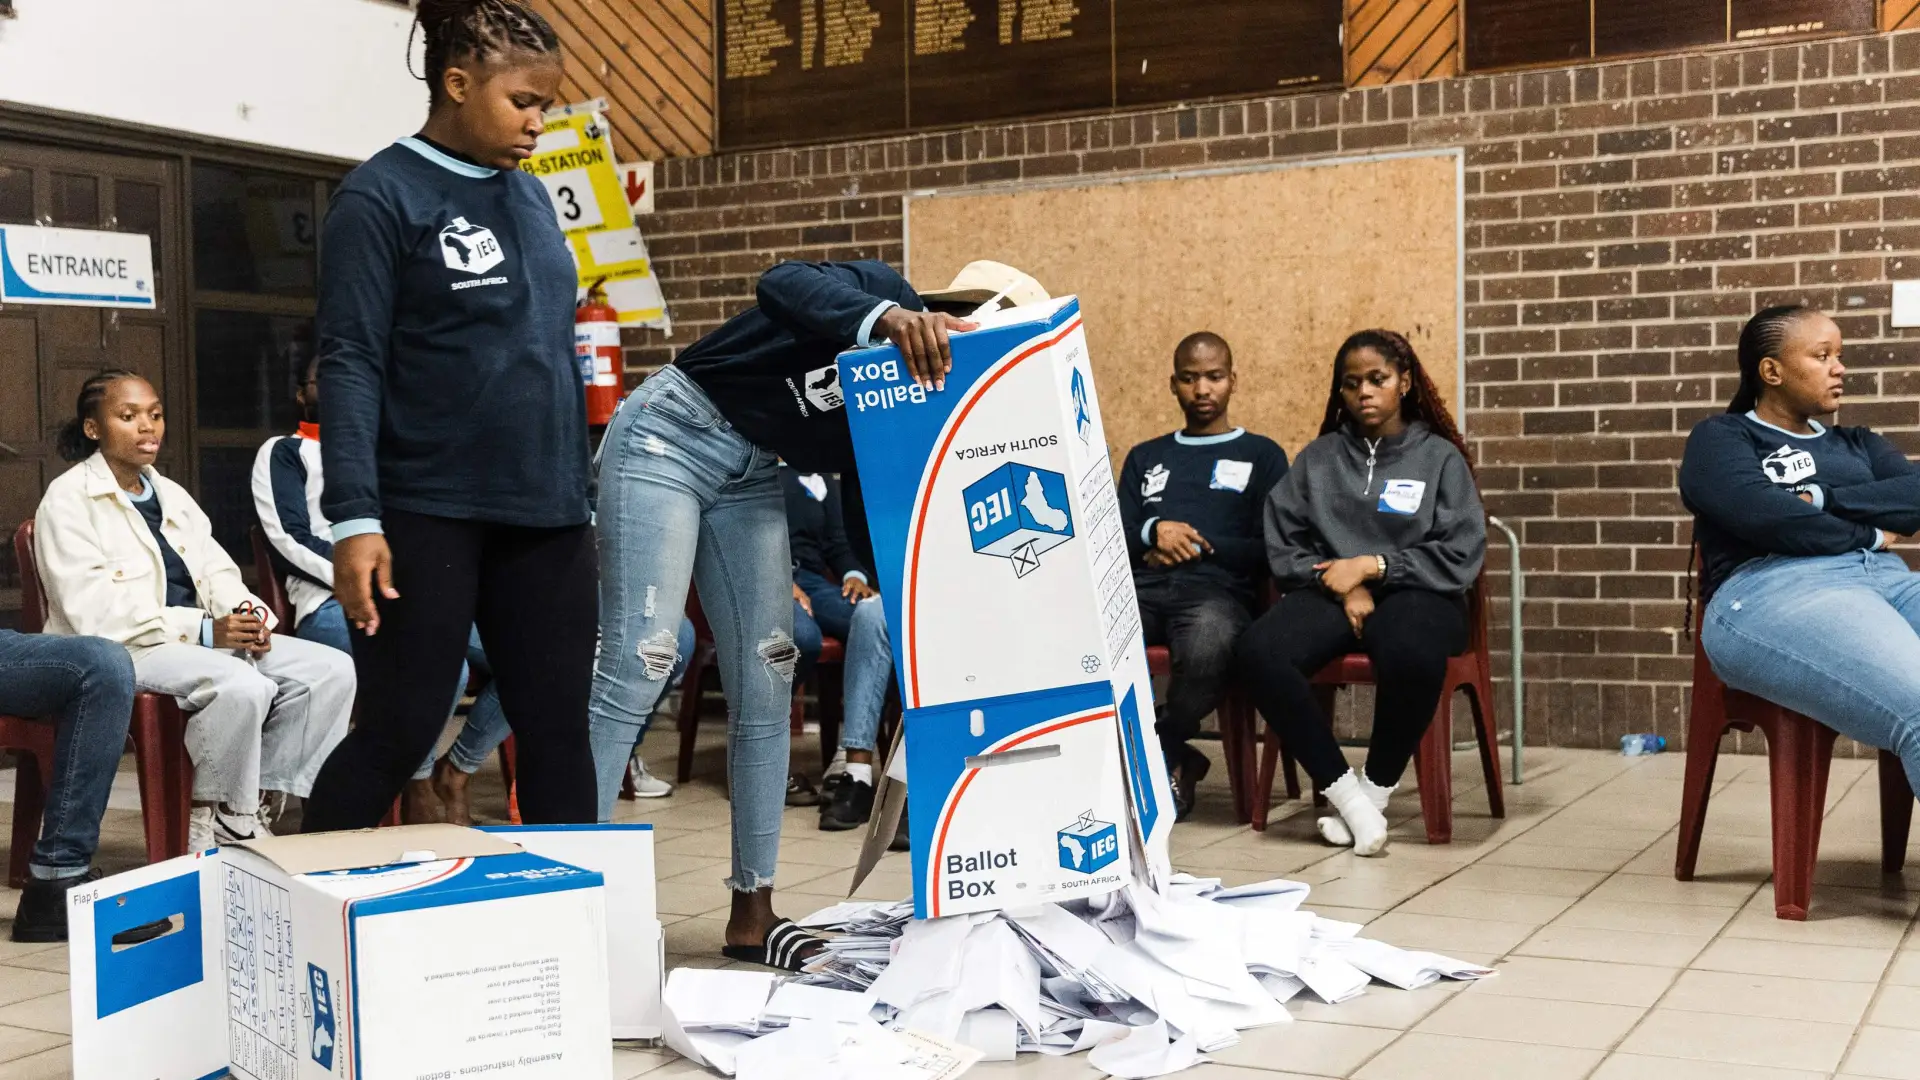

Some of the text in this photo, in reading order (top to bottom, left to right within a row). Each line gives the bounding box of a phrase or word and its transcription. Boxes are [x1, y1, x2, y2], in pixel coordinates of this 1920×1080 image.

[522, 149, 604, 176] B-STATION
[557, 186, 581, 220] 3
[476, 238, 496, 259] IEC
[28, 253, 128, 279] ENTRANCE
[451, 279, 480, 290] SOUTH
[850, 360, 900, 382] Box
[785, 377, 800, 397] SOUTH
[820, 392, 844, 407] IEC
[855, 383, 927, 412] Ballot
[955, 435, 1058, 460] SOUTH AFRICA
[1793, 458, 1811, 472] IEC
[970, 487, 1012, 532] IEC
[1090, 834, 1116, 860] IEC
[947, 848, 1017, 874] Ballot
[948, 880, 996, 900] Box
[1061, 875, 1121, 889] SOUTH AFRICA
[73, 889, 99, 906] Flap 6
[430, 971, 455, 980] marked
[472, 965, 497, 975] through
[508, 978, 531, 986] marked
[313, 969, 328, 1015] IEC
[509, 994, 532, 1002] marked
[509, 1010, 533, 1019] marked
[510, 1027, 533, 1035] marked
[459, 1059, 515, 1075] instructions
[518, 1052, 563, 1066] Assembly
